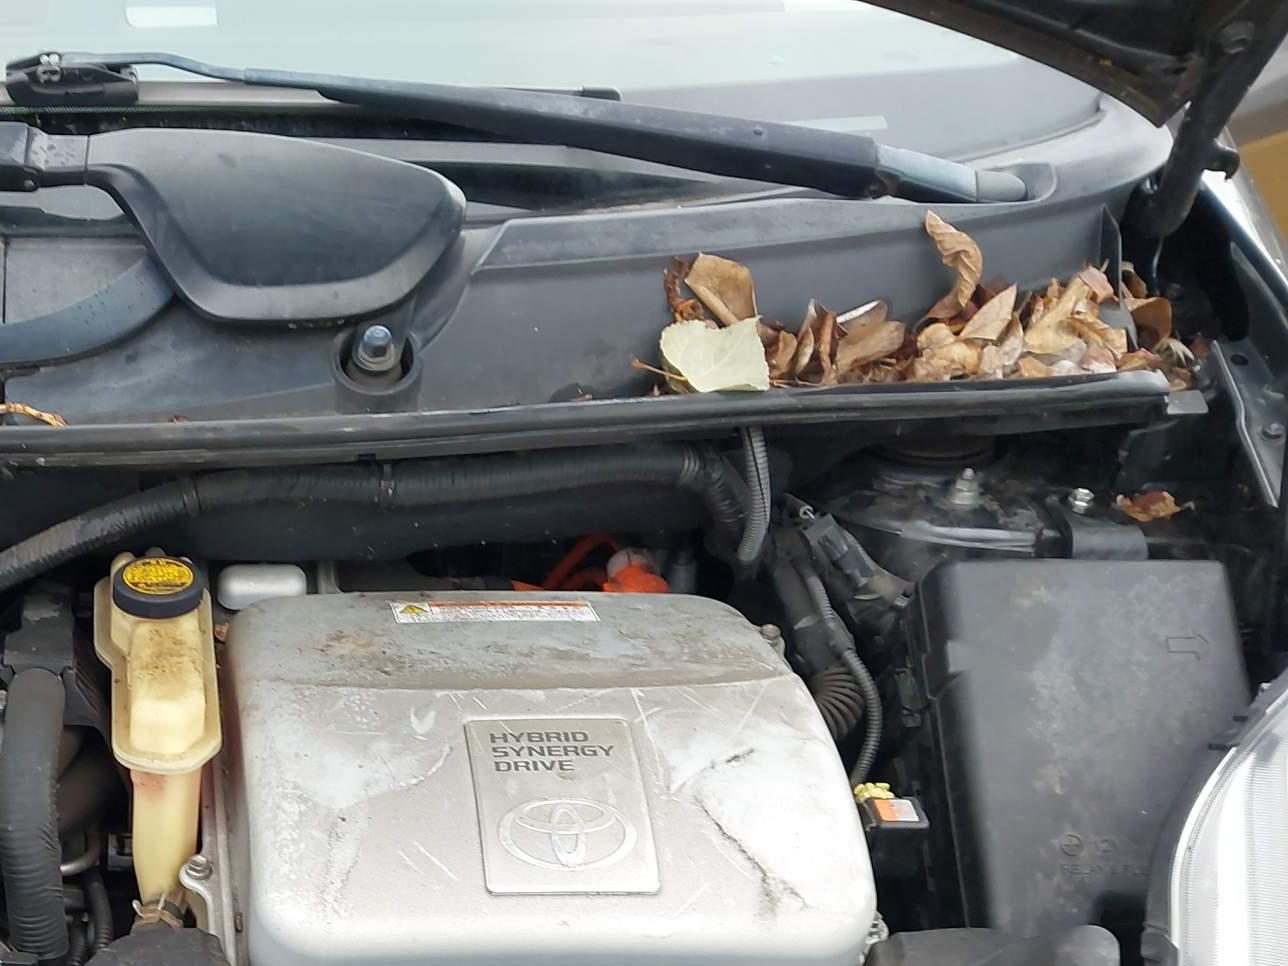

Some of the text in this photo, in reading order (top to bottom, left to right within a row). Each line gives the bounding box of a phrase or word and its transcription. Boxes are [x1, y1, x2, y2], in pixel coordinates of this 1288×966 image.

[489, 731, 589, 743] HYBRID
[491, 745, 614, 758] SYNERGY
[494, 759, 575, 772] DRIVE
